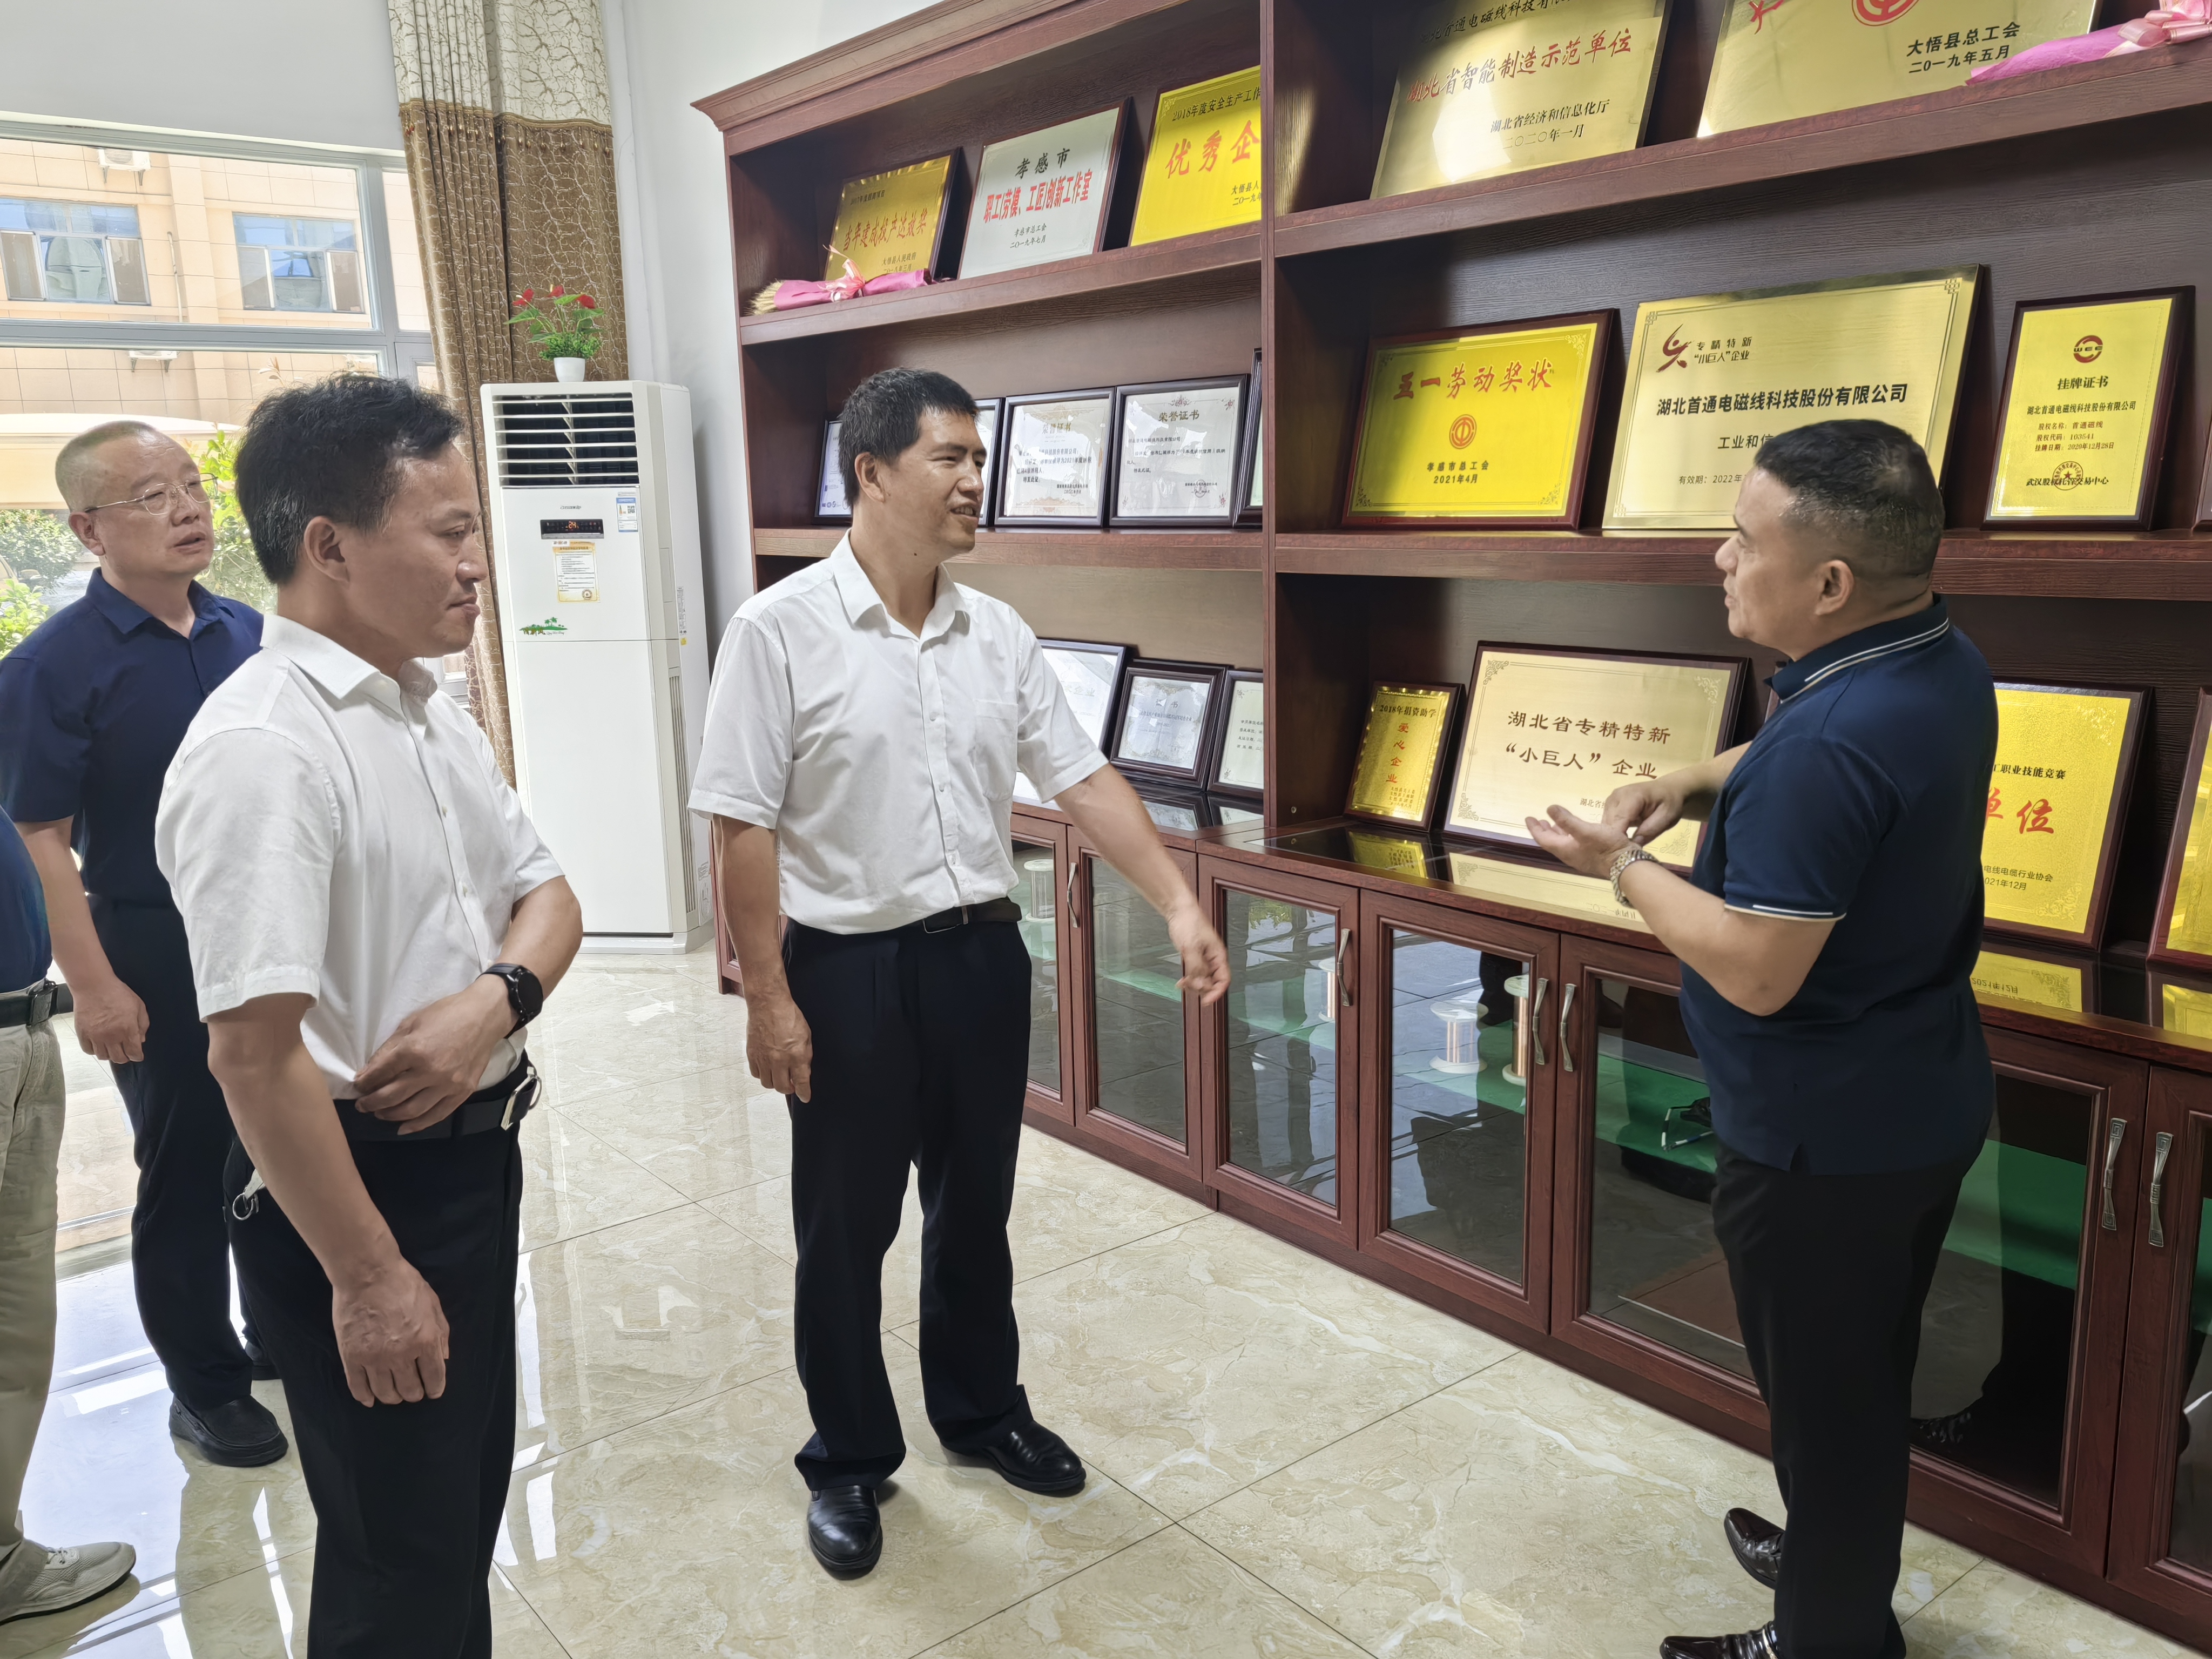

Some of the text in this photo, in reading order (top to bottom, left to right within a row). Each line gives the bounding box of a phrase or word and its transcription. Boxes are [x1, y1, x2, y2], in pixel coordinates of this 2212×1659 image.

[1420, 0, 1566, 43] 湖北首通电磁线科技有
[1906, 22, 2021, 57] 大悟县总工会
[1407, 28, 1631, 103] 湖北省智能制造示范单位
[1491, 99, 1610, 133] 湖北省经济和信息化厅
[1165, 119, 1260, 179] 优秀企
[1015, 147, 1070, 179] 孝感市
[1231, 180, 1262, 195] 大悟县人
[1014, 222, 1047, 238] 孝感市总工会
[1697, 336, 1752, 350] 专精特新
[1393, 359, 1552, 400] 五一劳动奖状
[2057, 375, 2109, 390] 挂牌证书
[1656, 383, 1908, 416] 湖北首通电磁线科技股份有限公司
[2027, 401, 2136, 415] 湖北首通电磁线科技股份有限公司
[1158, 409, 1199, 422] 荣誉证书
[1427, 460, 1489, 472] 孝感市总工会
[1433, 474, 1478, 484] 2021年4月
[1679, 474, 1746, 484] 有效期：2022年
[1379, 705, 1437, 718] 2018年捐资助学
[1508, 711, 1671, 744] 湖北省专精特新
[1386, 723, 1409, 783] 爱心企业
